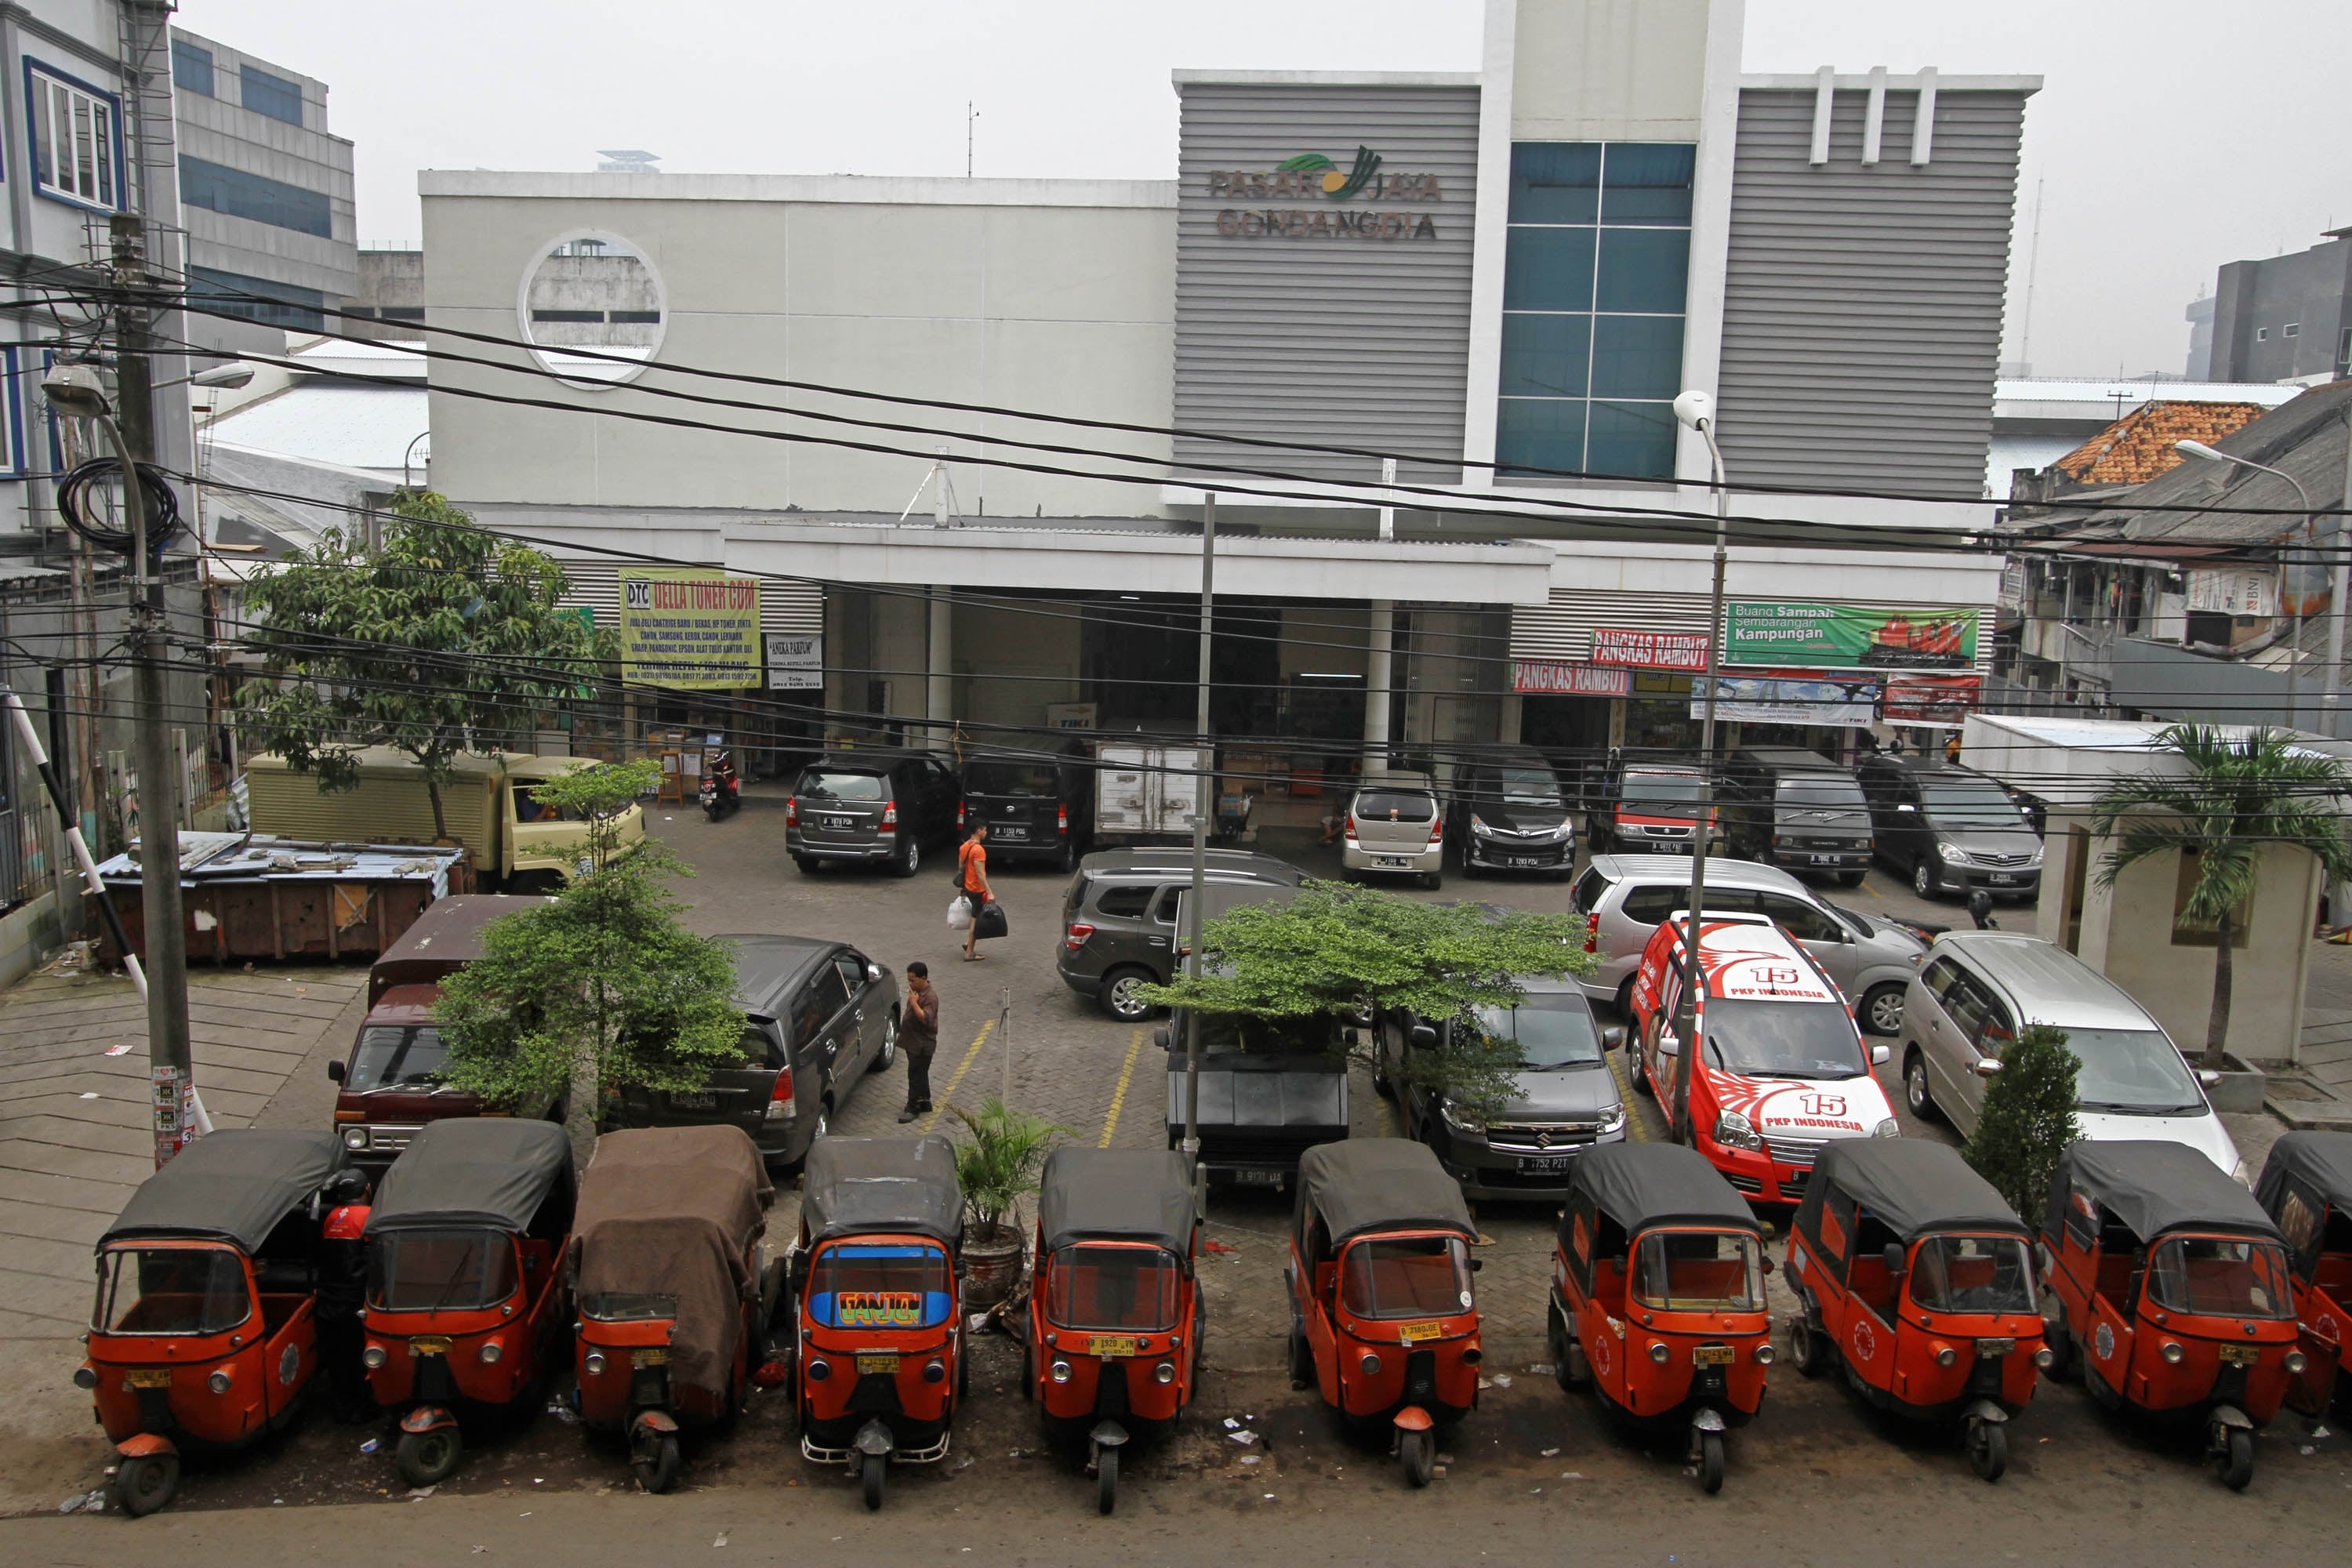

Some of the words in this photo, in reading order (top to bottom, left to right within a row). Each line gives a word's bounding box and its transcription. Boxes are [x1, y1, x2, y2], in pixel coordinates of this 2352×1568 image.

[1208, 169, 1317, 198] PASAR
[1367, 172, 1443, 201] JAYA
[1216, 208, 1438, 240] GONDANGDIA
[628, 583, 649, 604] DTC
[654, 580, 687, 609] DELLA
[689, 580, 727, 610] TONER
[728, 580, 756, 609] COM
[2246, 577, 2259, 599] BNI
[1736, 605, 1773, 618] Buang
[1735, 618, 1817, 629] Sembarangan
[1735, 628, 1824, 642] Kampungan
[1593, 630, 1653, 663] PANGKAS
[1654, 635, 1708, 666] RAMBUT
[1514, 660, 1573, 691] PANGKAS
[1575, 663, 1628, 691] RAMBUT
[1749, 967, 1798, 984] 15
[1759, 988, 1826, 999] INDONESIA
[1799, 1093, 1847, 1116] 15
[1765, 1117, 1791, 1127] PKP
[1794, 1117, 1864, 1132] INDONESIA
[183, 1131, 191, 1143] 3
[1518, 1158, 1524, 1167] B
[1552, 1158, 1568, 1168] PZT
[1793, 1171, 1799, 1181] B
